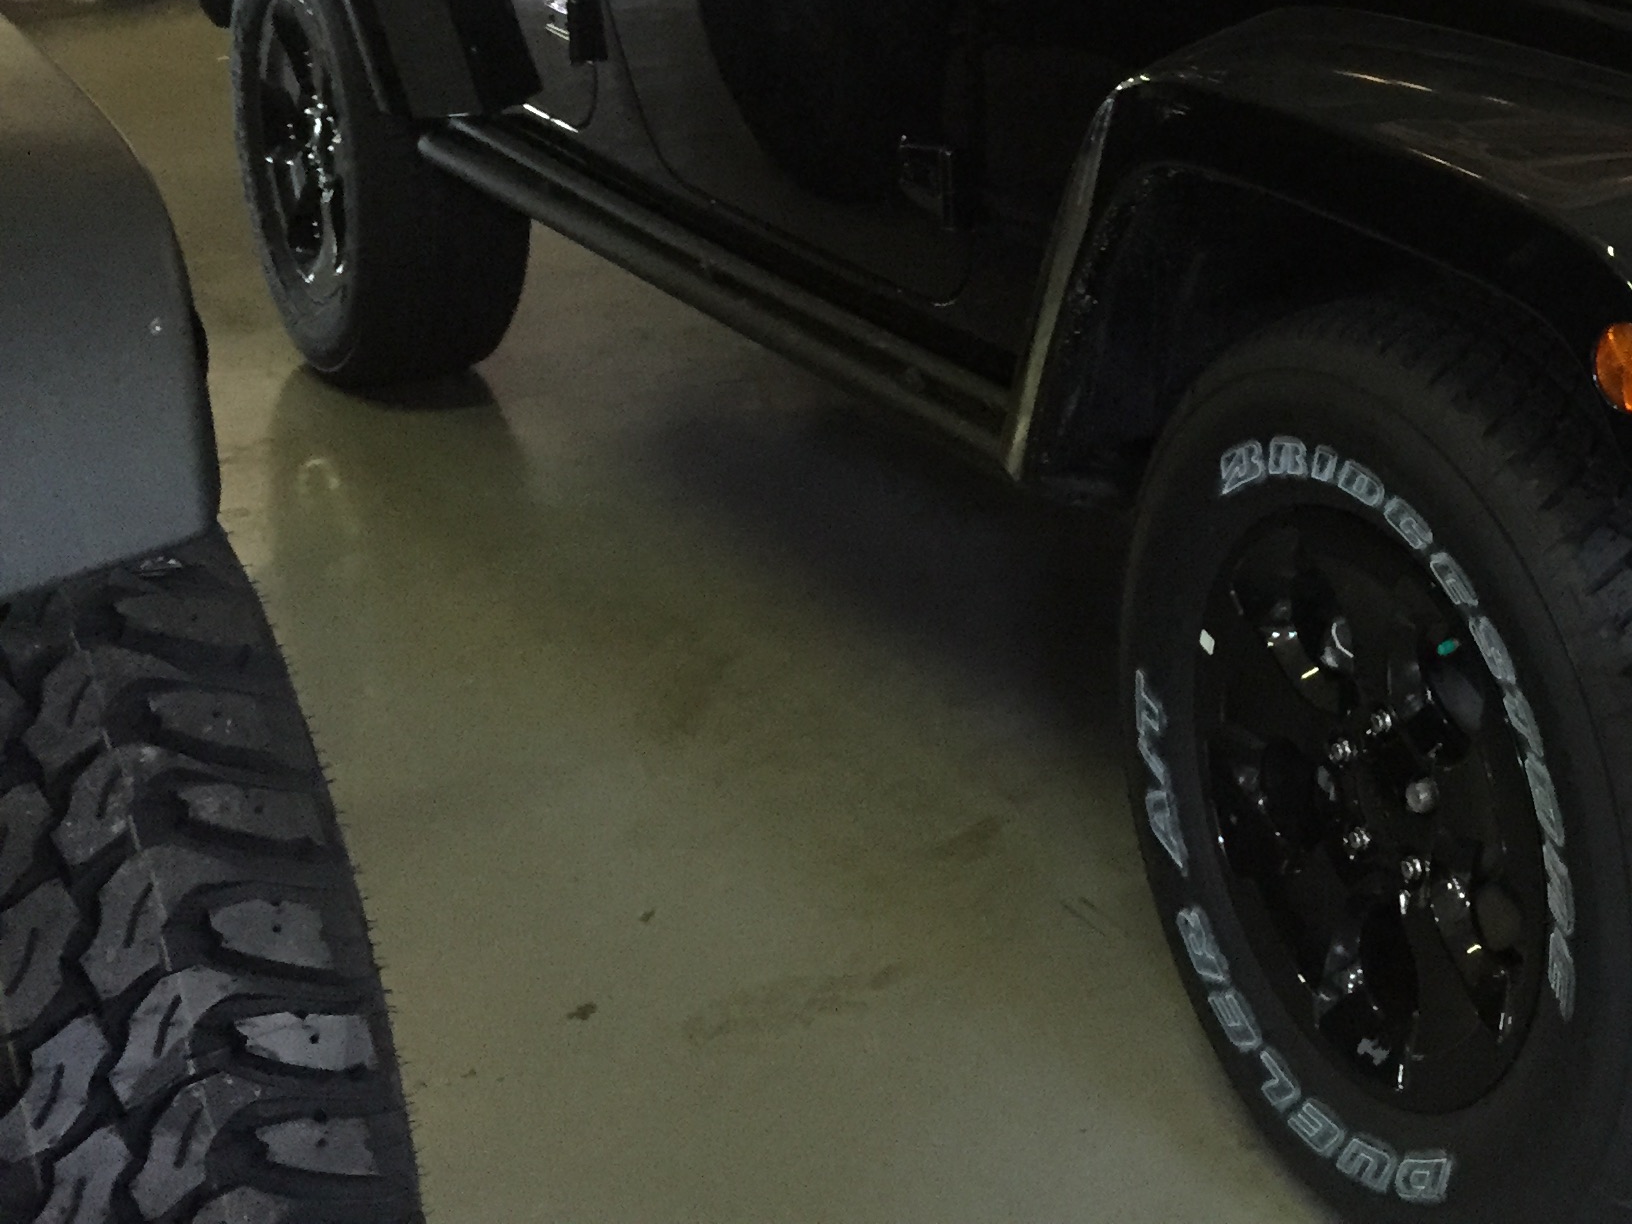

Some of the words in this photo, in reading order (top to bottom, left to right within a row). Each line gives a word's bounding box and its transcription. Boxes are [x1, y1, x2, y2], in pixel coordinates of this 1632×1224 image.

[1134, 669, 1189, 877] A/T
[1221, 436, 1575, 1020] BRIDGESTONE
[1177, 906, 1453, 1202] DUELER
